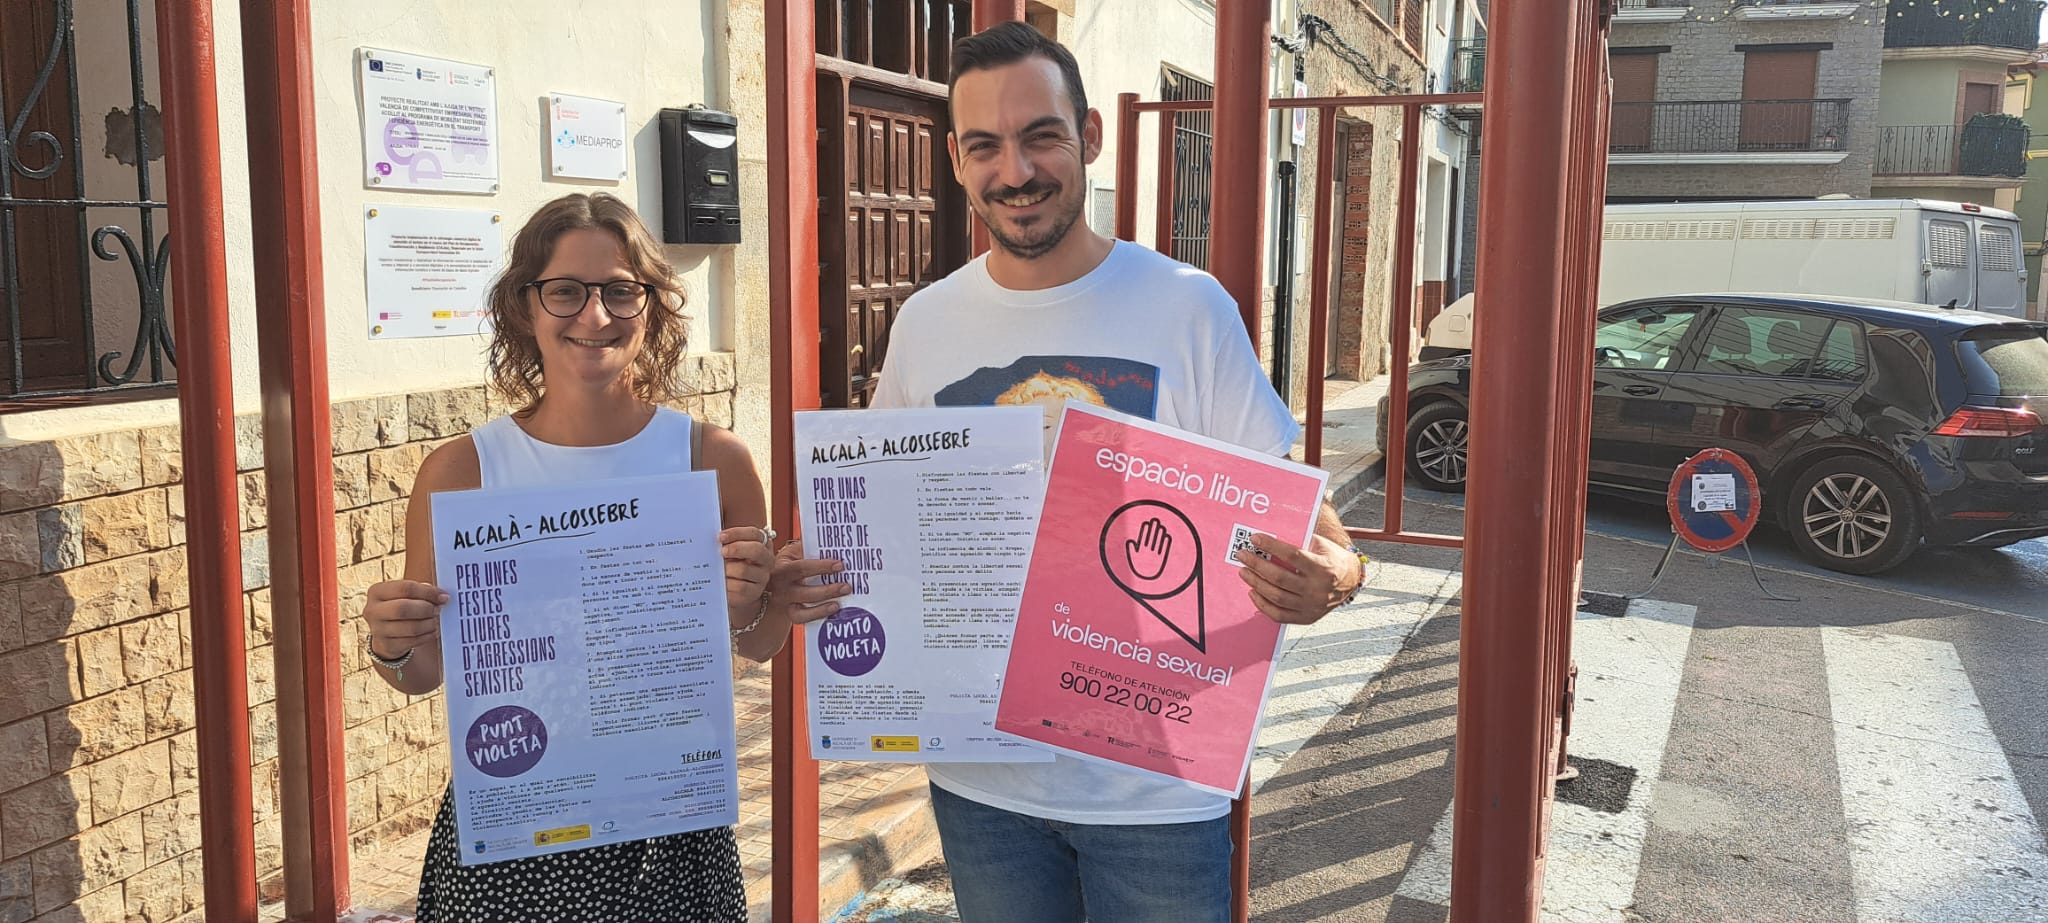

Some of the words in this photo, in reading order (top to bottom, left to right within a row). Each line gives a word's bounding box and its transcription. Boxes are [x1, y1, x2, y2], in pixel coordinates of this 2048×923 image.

[576, 136, 622, 150] MEDIAPROP
[812, 436, 867, 464] ALCALÀ
[882, 428, 971, 456] ALCOSSEBRE
[813, 477, 834, 499] POR
[838, 476, 866, 499] UNAS
[1096, 448, 1204, 494] espacio
[1208, 473, 1270, 514] libre
[454, 514, 520, 550] ALCALÀ
[539, 498, 640, 534] ALCOSSEBRE
[815, 501, 856, 523] FIESTAS
[816, 525, 852, 547] LIBRES
[856, 525, 869, 547] DE
[456, 563, 480, 589] PER
[484, 559, 518, 586] UNES
[458, 588, 502, 616] FESTES
[1054, 602, 1070, 614] de
[459, 614, 510, 643] LLIURES
[825, 616, 871, 639] PUNTO
[461, 635, 556, 671] D'AGRESSIONS
[823, 639, 881, 661] VIOLETA
[1052, 618, 1152, 664] violencia
[1156, 652, 1234, 686] sexual
[464, 666, 524, 697] SEXISTES
[1071, 660, 1122, 682] TELÉFONO
[1124, 677, 1138, 687] DE
[1139, 681, 1190, 702] ATENCIÓN
[1060, 672, 1101, 698] 900
[1104, 686, 1131, 707] 22
[1134, 694, 1162, 715] 00
[1165, 702, 1192, 724] 22
[479, 715, 523, 742] PUNT
[473, 736, 542, 766] VIOLETA
